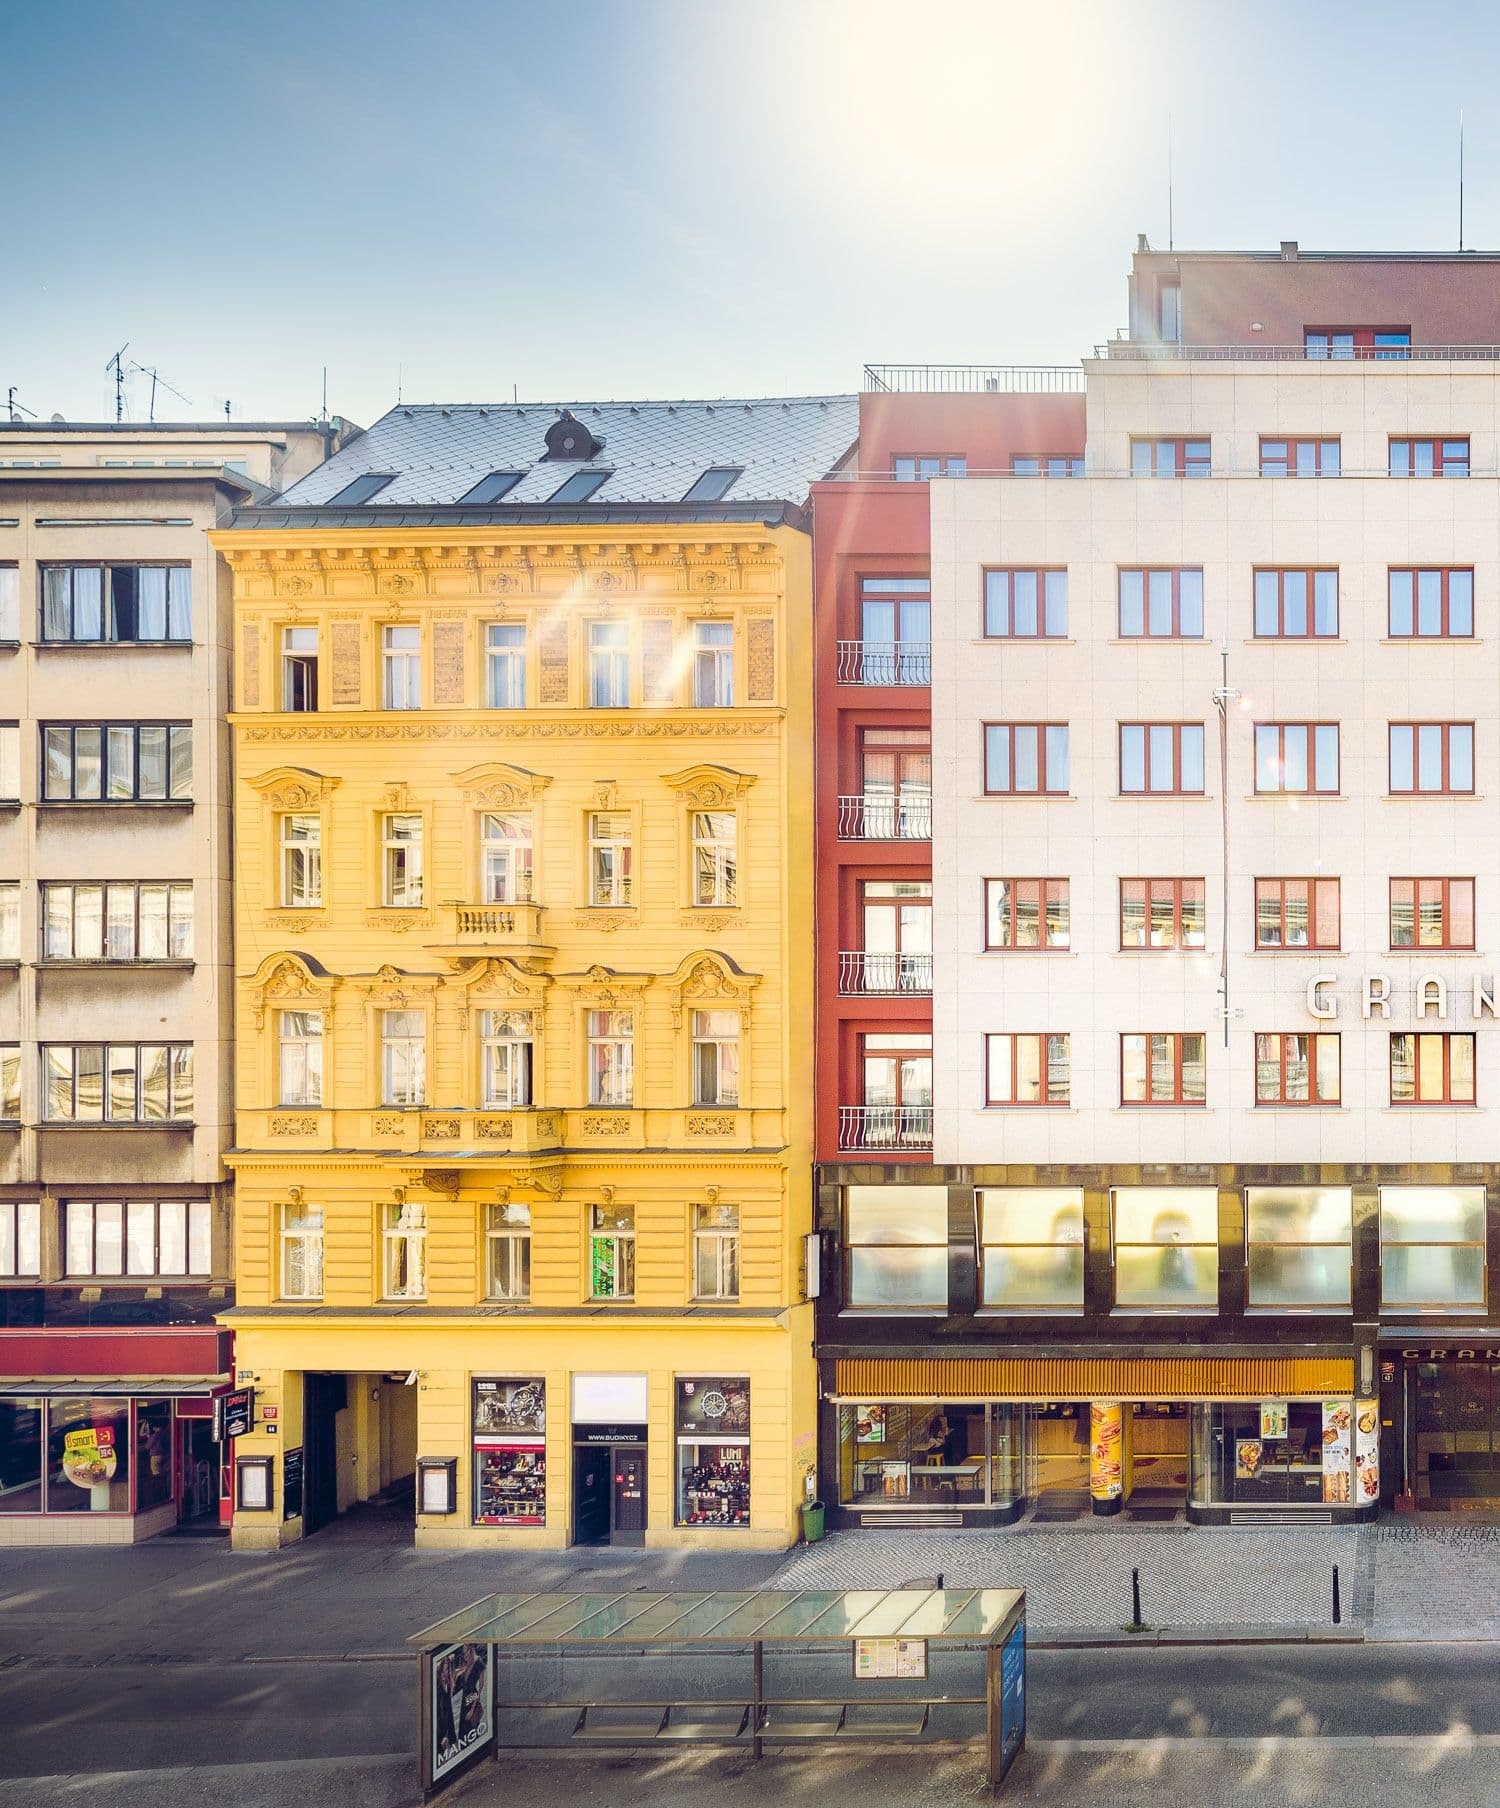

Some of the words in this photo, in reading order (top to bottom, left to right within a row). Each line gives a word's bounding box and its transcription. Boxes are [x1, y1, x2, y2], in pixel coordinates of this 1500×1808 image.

[720, 1447, 742, 1460] LUMI
[72, 1470, 88, 1479] KFC
[437, 1722, 487, 1766] MANGO
